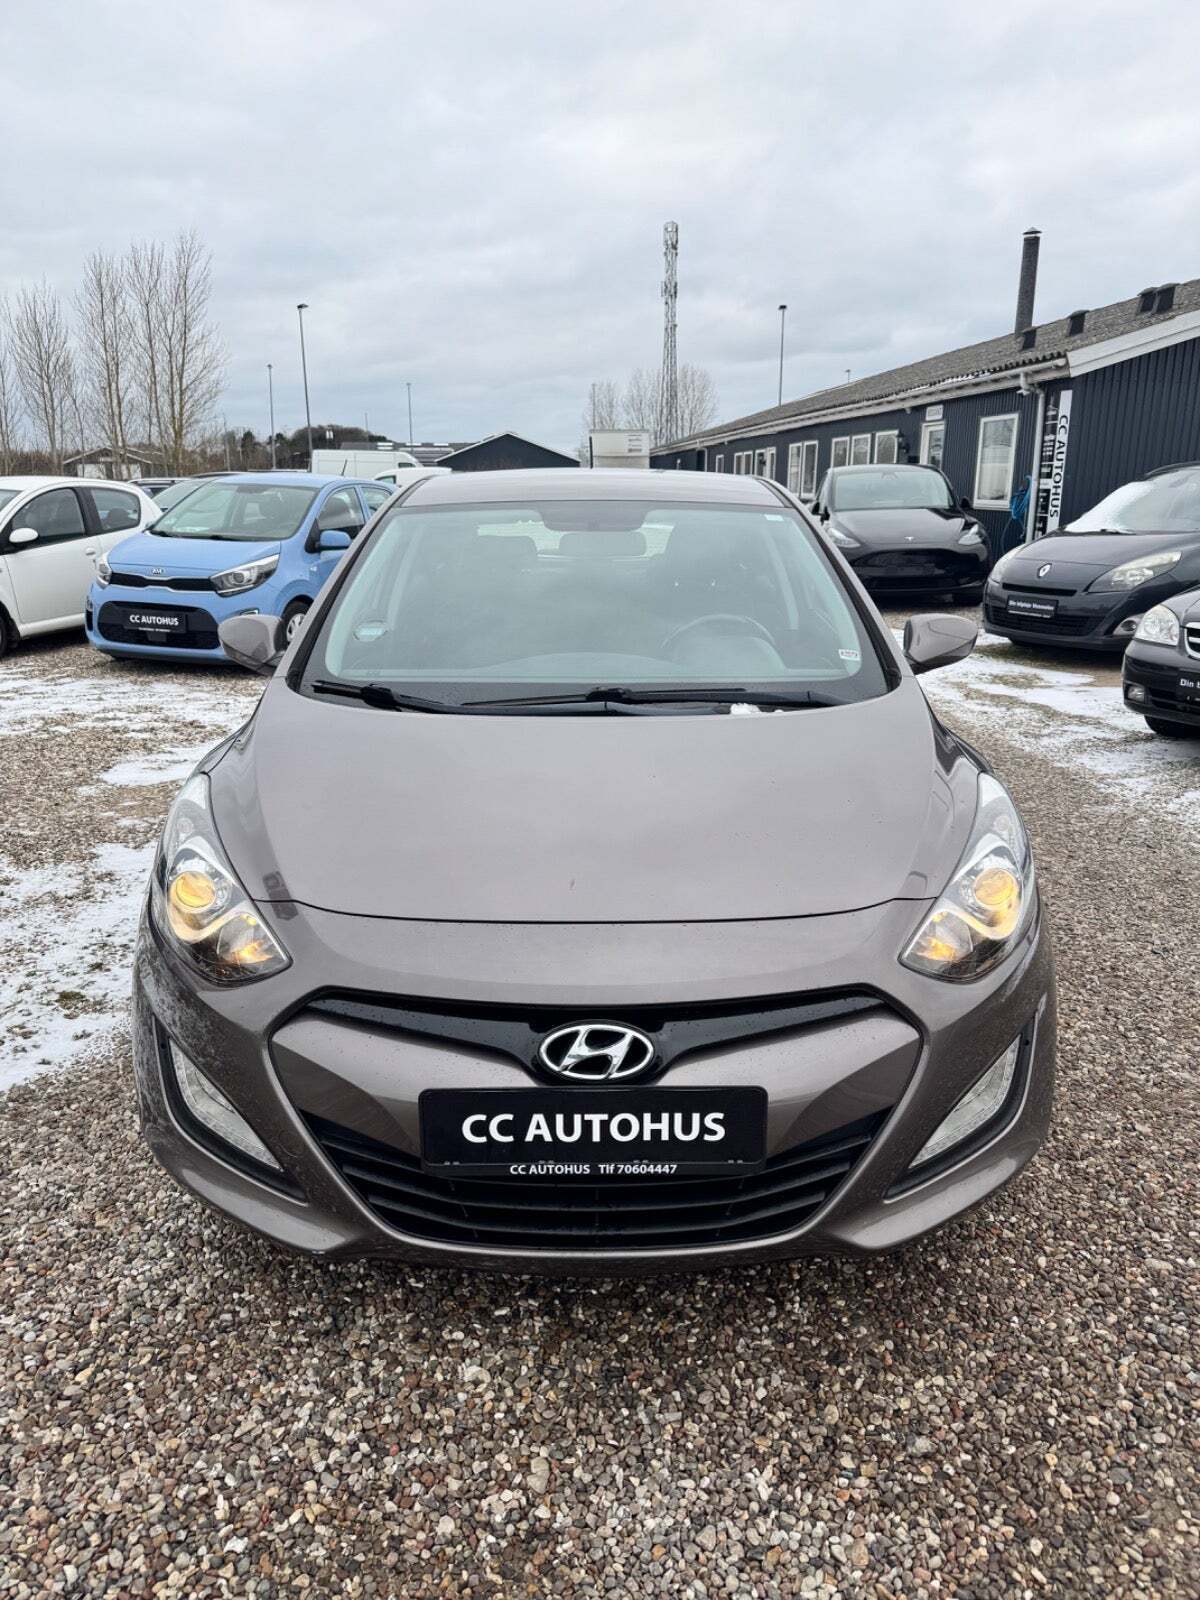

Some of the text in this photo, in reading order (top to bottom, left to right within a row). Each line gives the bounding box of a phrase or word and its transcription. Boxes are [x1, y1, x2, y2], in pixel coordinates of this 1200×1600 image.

[1050, 415, 1069, 518] CC AUTOHUS
[129, 614, 179, 626] CC AUTOHUS
[1180, 678, 1194, 688] Din
[461, 1112, 726, 1143] CC AUTOHUS
[509, 1164, 677, 1175] CC AUTOHUS Tlf 70604447
